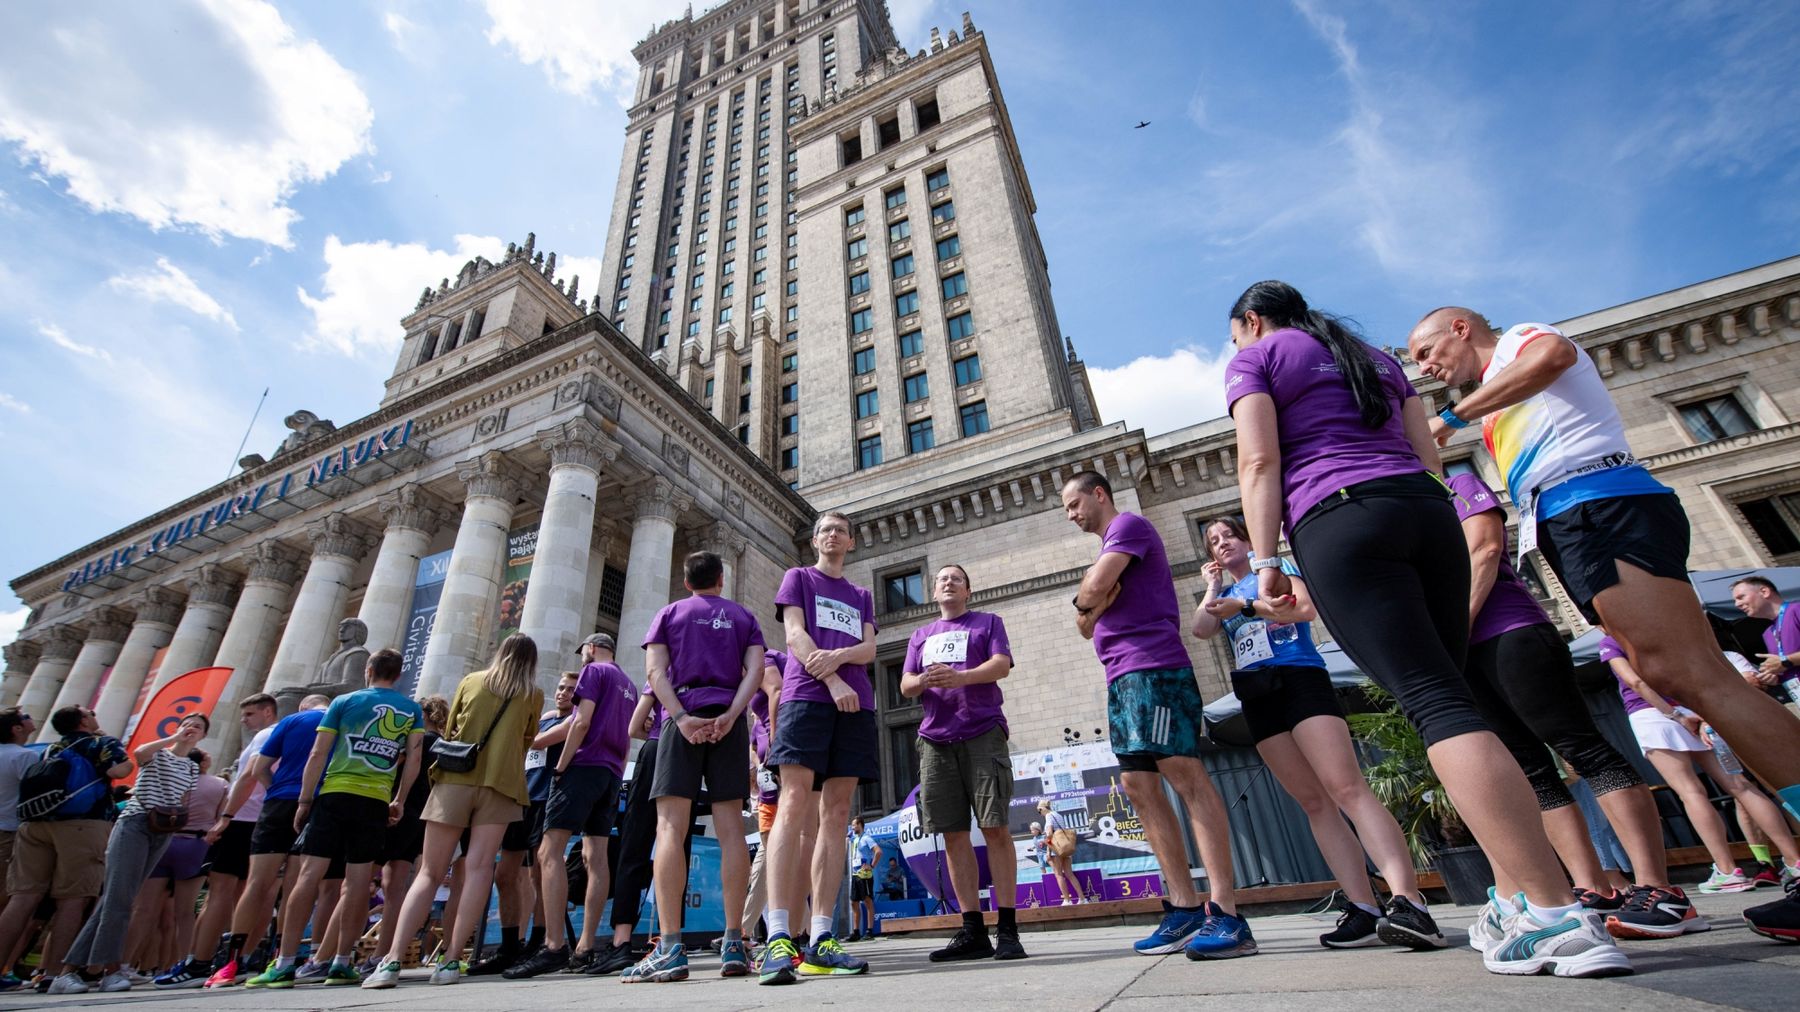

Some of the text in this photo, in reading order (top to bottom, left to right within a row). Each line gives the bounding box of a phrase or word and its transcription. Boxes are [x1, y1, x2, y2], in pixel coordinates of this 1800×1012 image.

[143, 483, 269, 557] KULTURY
[276, 472, 293, 499] I
[304, 419, 414, 488] NAUKI
[713, 619, 721, 629] 8
[830, 611, 851, 626] 162
[401, 615, 425, 673] Civitas
[866, 826, 894, 837] AWER
[1098, 816, 1120, 844] 8
[1116, 820, 1138, 830] BIEG
[900, 823, 930, 844] olo
[1120, 880, 1131, 896] 3
